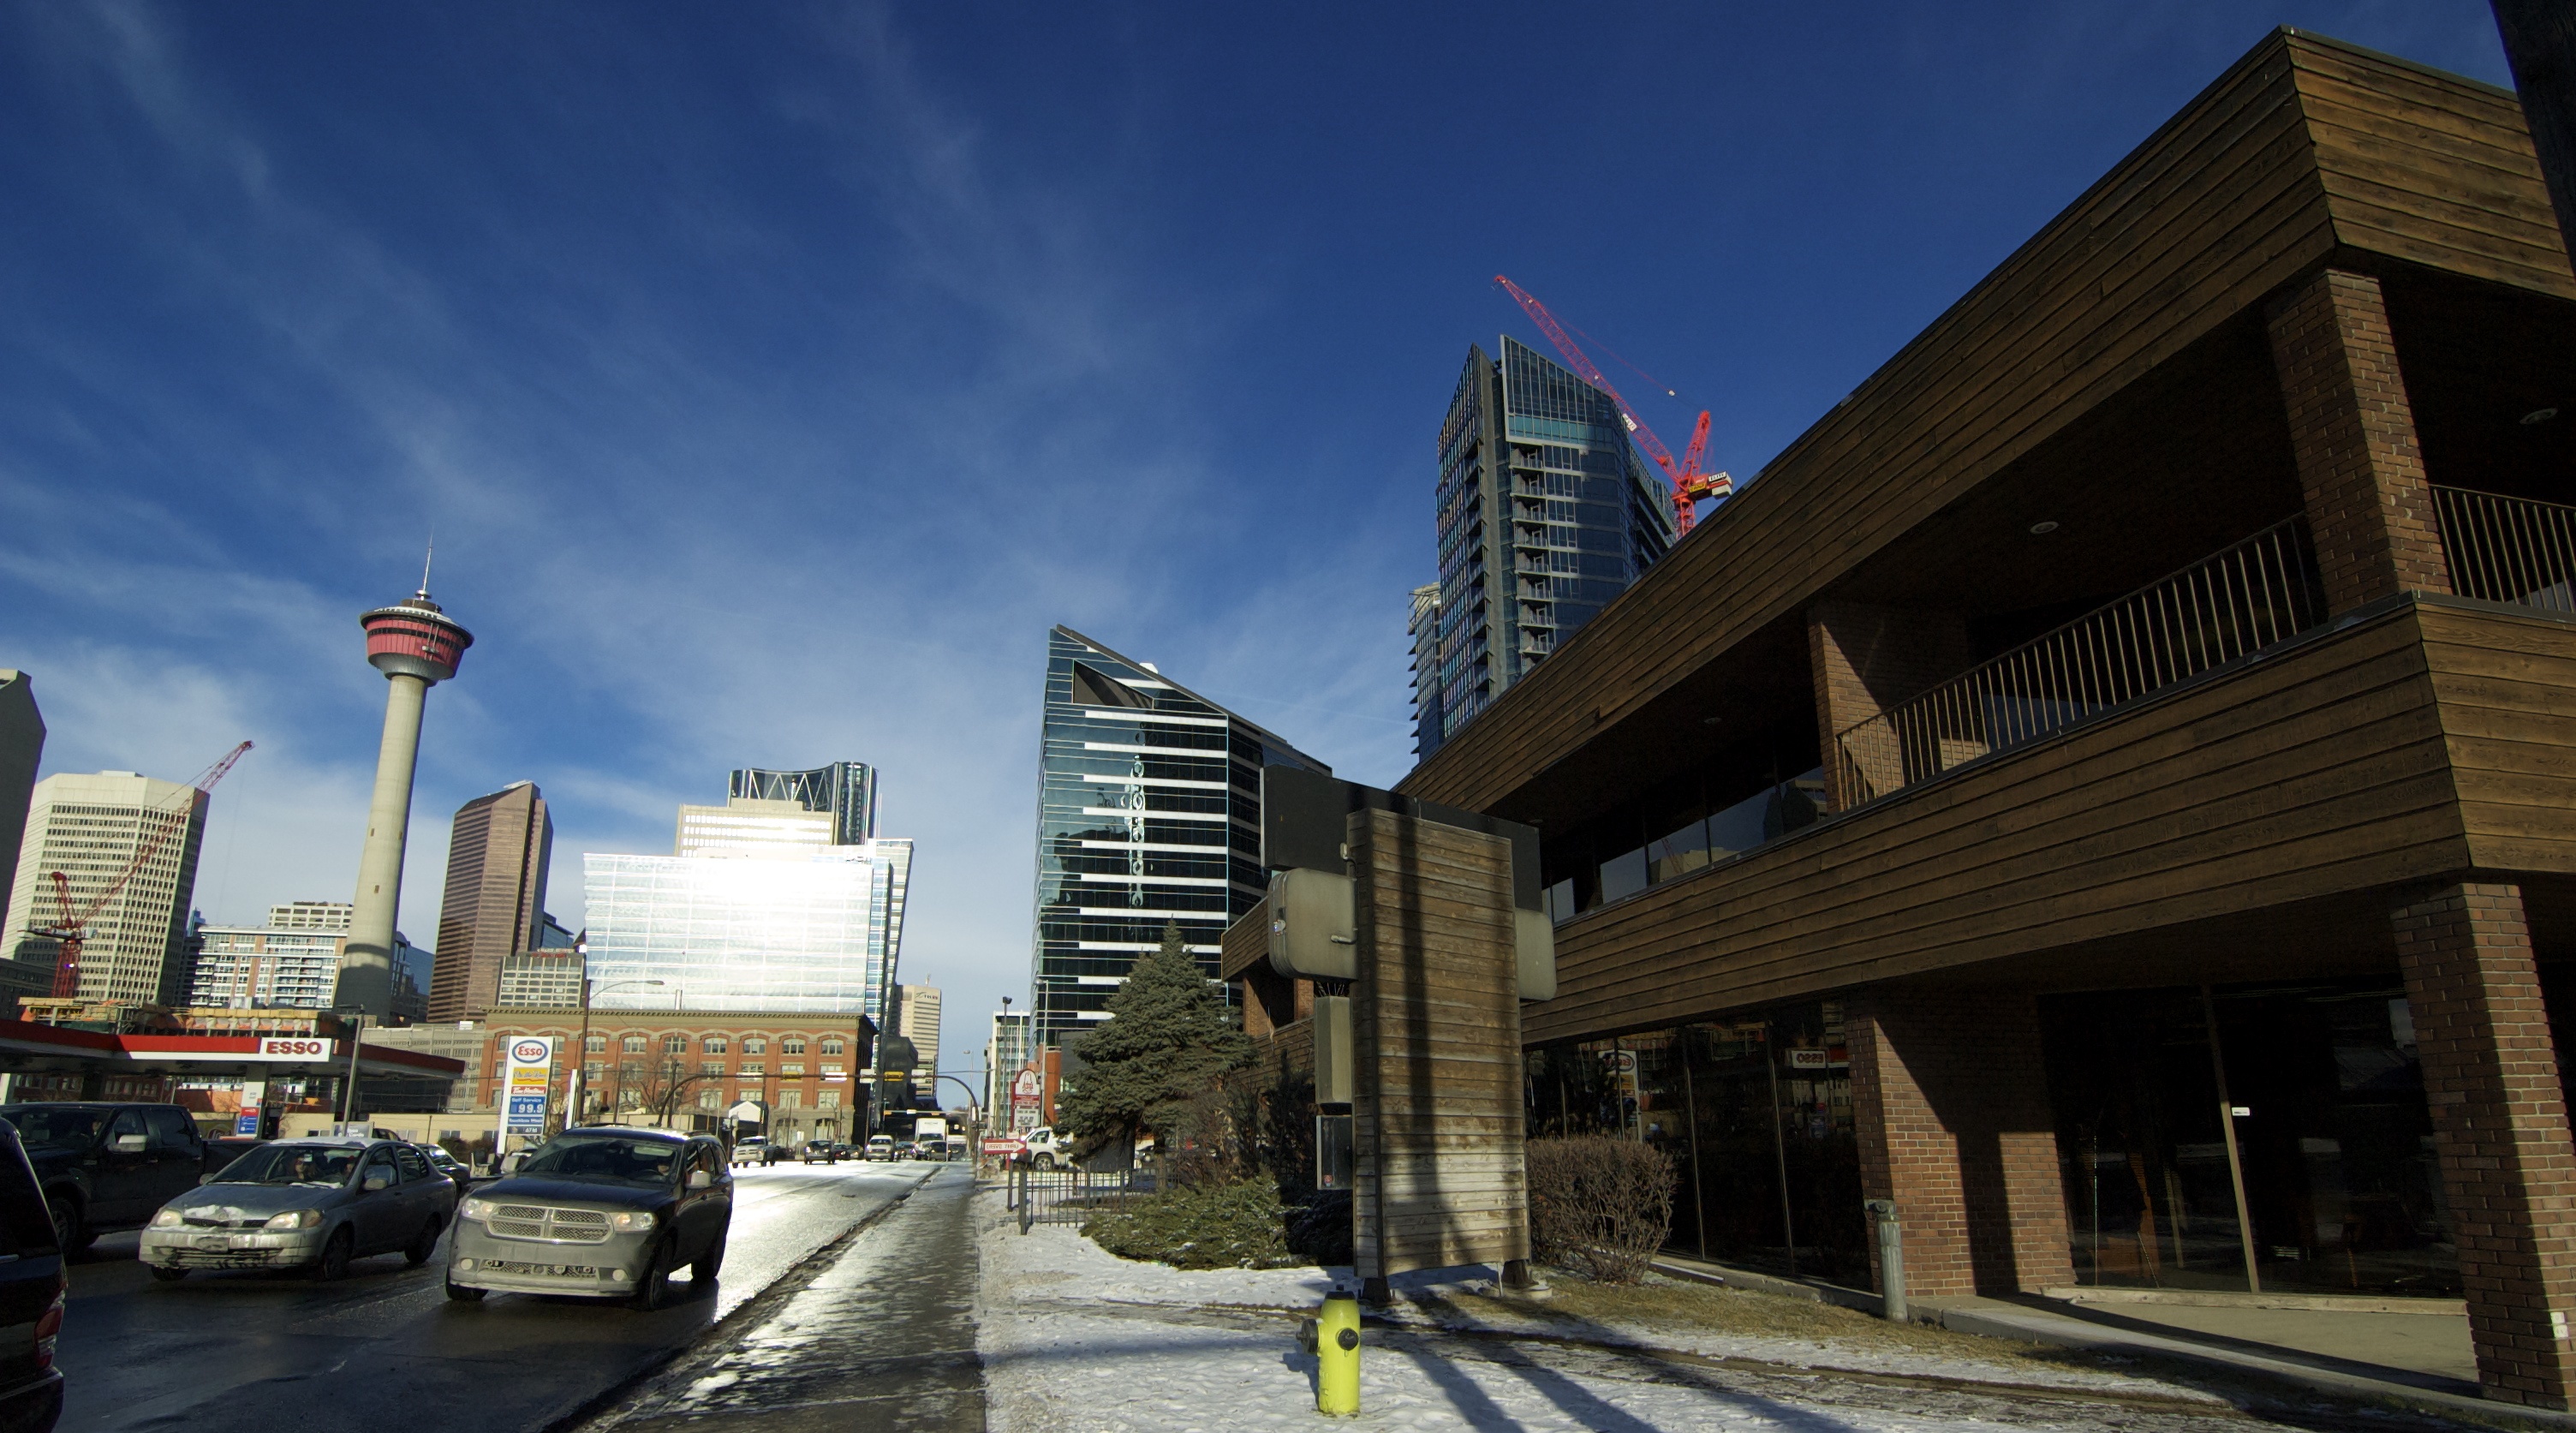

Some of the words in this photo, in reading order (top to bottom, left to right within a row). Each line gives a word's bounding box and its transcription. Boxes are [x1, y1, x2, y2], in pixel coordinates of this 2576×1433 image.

[266, 1041, 322, 1054] ESSO
[518, 1045, 543, 1056] Esso
[518, 1103, 544, 1114] 99.9
